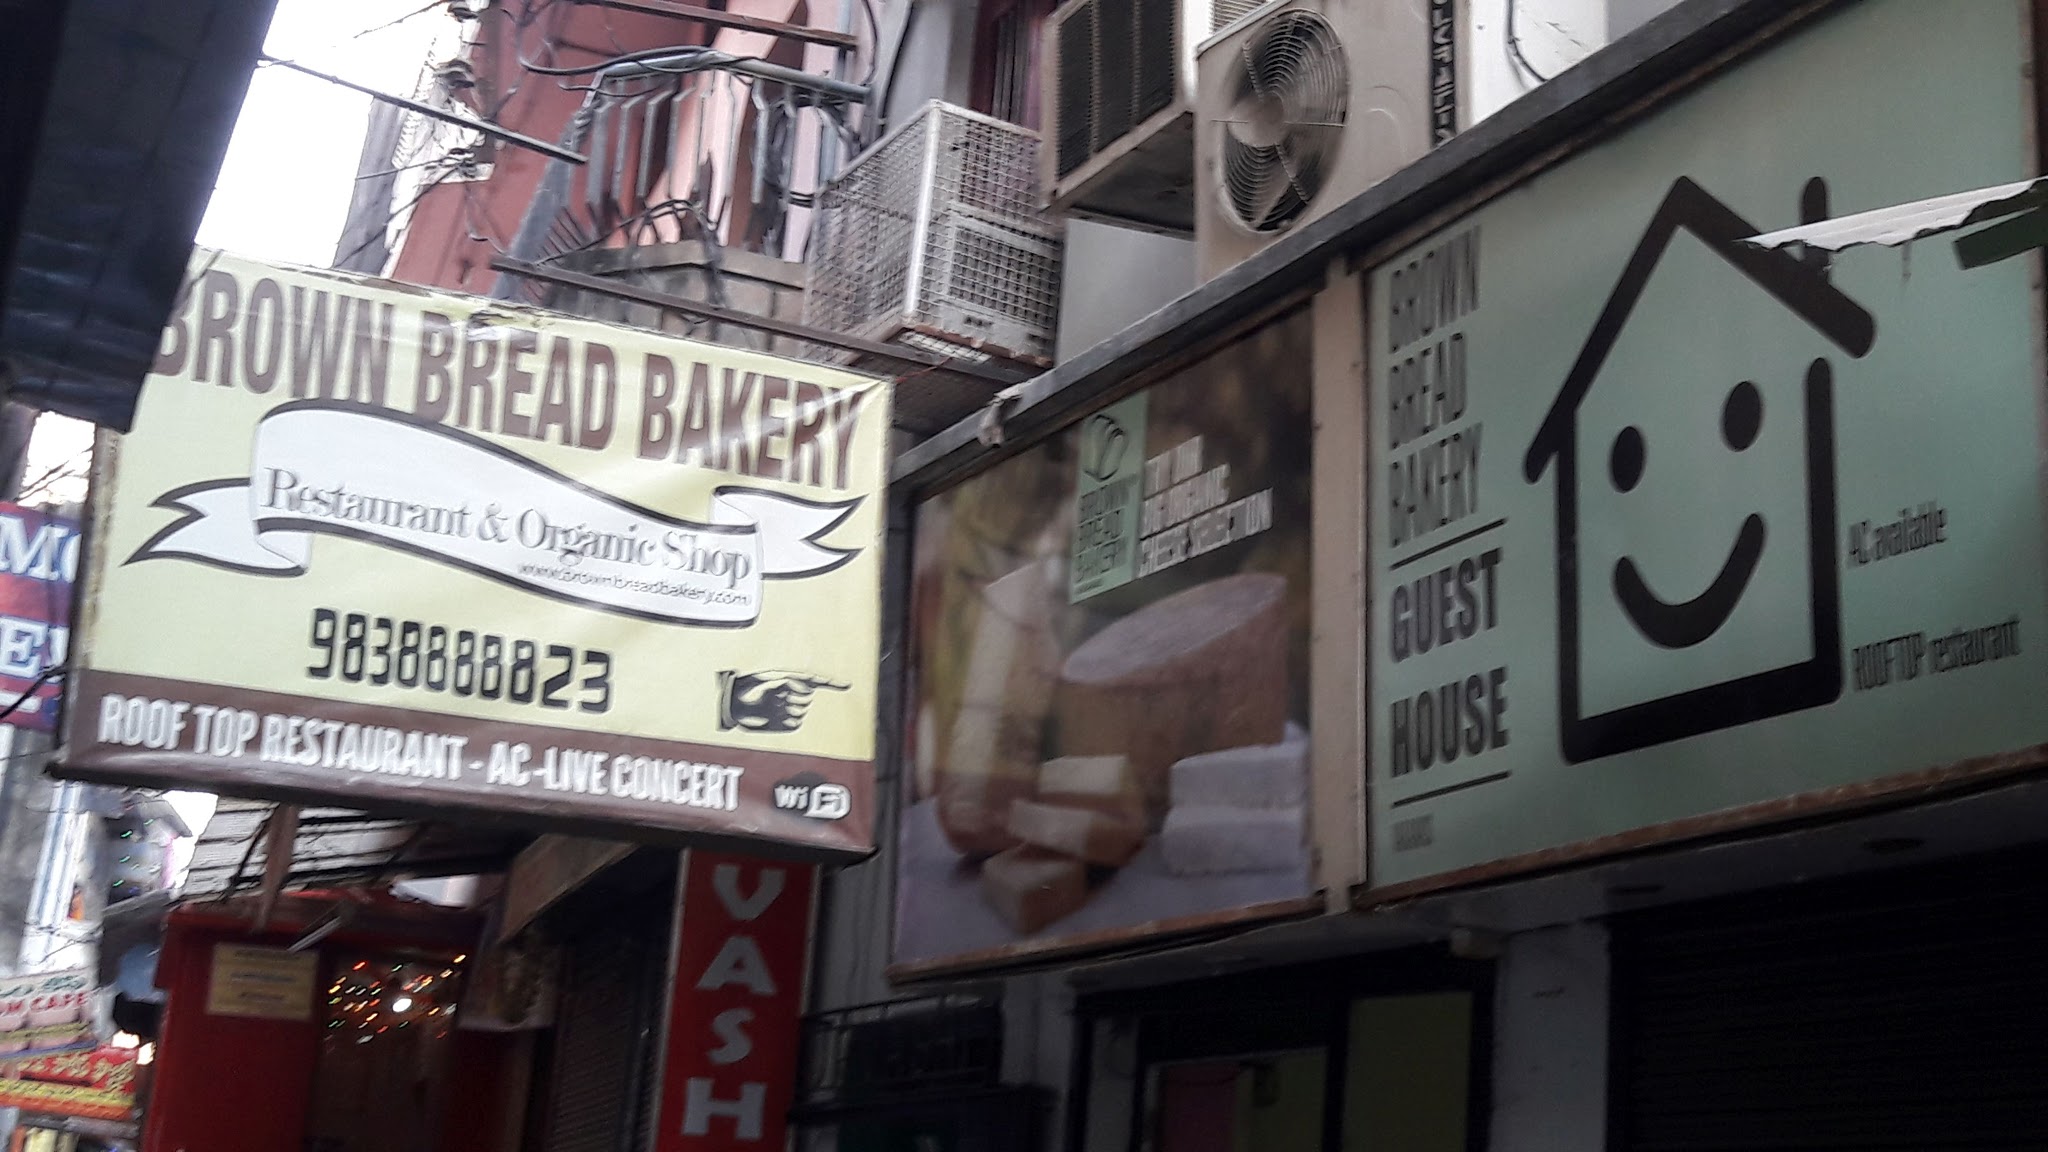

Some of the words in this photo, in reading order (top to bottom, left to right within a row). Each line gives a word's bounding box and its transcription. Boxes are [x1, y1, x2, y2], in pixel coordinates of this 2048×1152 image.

[1389, 223, 1482, 353] BROWN
[414, 308, 617, 451] BREAD
[636, 351, 868, 490] BAKERY
[1389, 331, 1467, 450] BREAD
[260, 466, 472, 538] Restaurant
[477, 502, 509, 543] &
[515, 507, 656, 566] Organic
[662, 530, 750, 589] Shop
[1389, 421, 1483, 549] BAKERY
[305, 608, 612, 713] 9838888823
[1390, 547, 1503, 663] GUEST
[98, 693, 191, 751] ROOF
[191, 702, 261, 758] TOP
[259, 713, 469, 782] RESTAURANT
[609, 754, 744, 811] CONCERT
[1391, 666, 1510, 778] HOUSE
